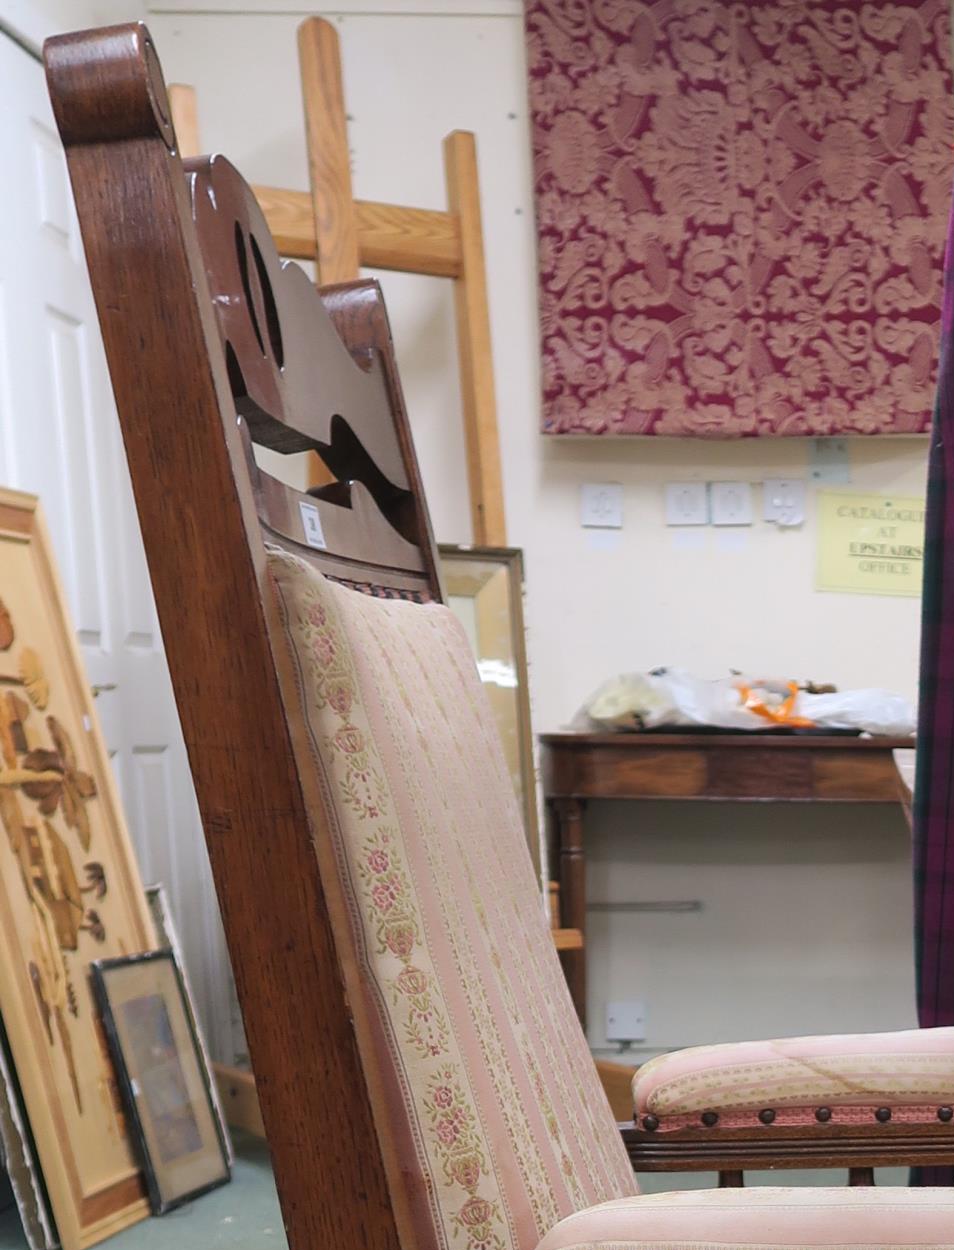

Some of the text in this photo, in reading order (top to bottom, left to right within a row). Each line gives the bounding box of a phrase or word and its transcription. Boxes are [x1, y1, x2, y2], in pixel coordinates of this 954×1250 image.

[878, 526, 897, 539] AT
[849, 541, 923, 557] UPSTAIRS
[858, 560, 911, 575] OFFICE
